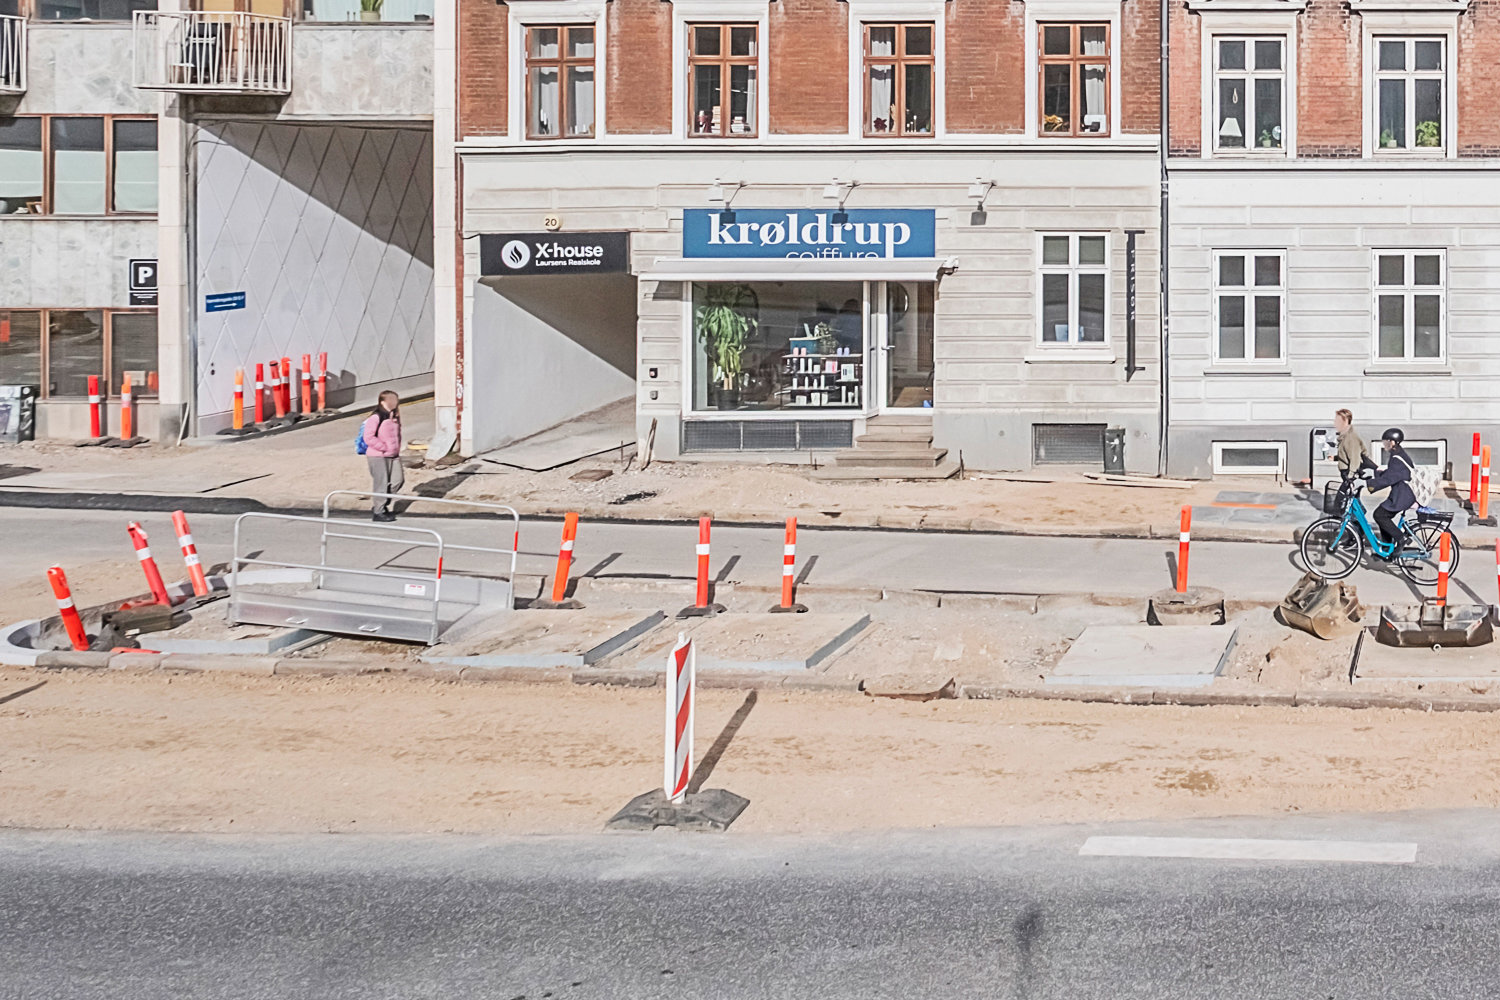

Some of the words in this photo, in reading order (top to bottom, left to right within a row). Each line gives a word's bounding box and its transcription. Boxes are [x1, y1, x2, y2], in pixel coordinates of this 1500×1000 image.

[545, 218, 557, 227] 20
[707, 213, 911, 258] krøldrup
[535, 242, 604, 258] X-house
[535, 259, 567, 267] Laursens
[568, 258, 601, 266] Realskole
[138, 266, 153, 284] P
